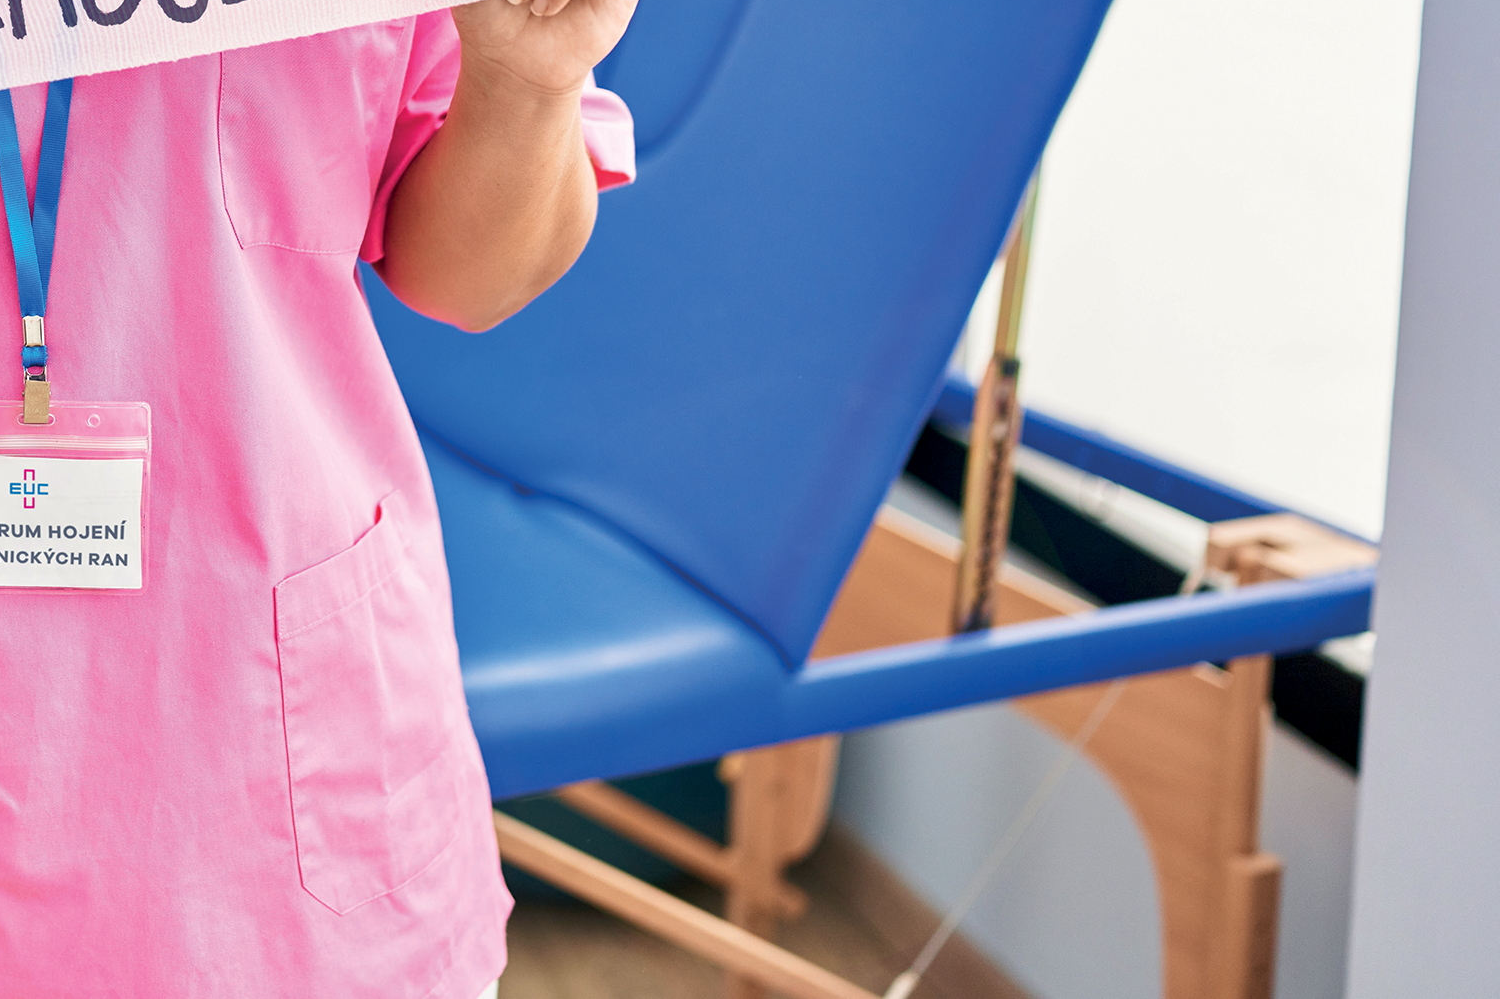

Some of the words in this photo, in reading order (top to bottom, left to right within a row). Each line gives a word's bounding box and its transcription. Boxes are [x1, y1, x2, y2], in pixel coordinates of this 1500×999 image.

[9, 482, 49, 496] EUC
[48, 520, 127, 540] HOJENÍ
[88, 552, 129, 567] RAN
